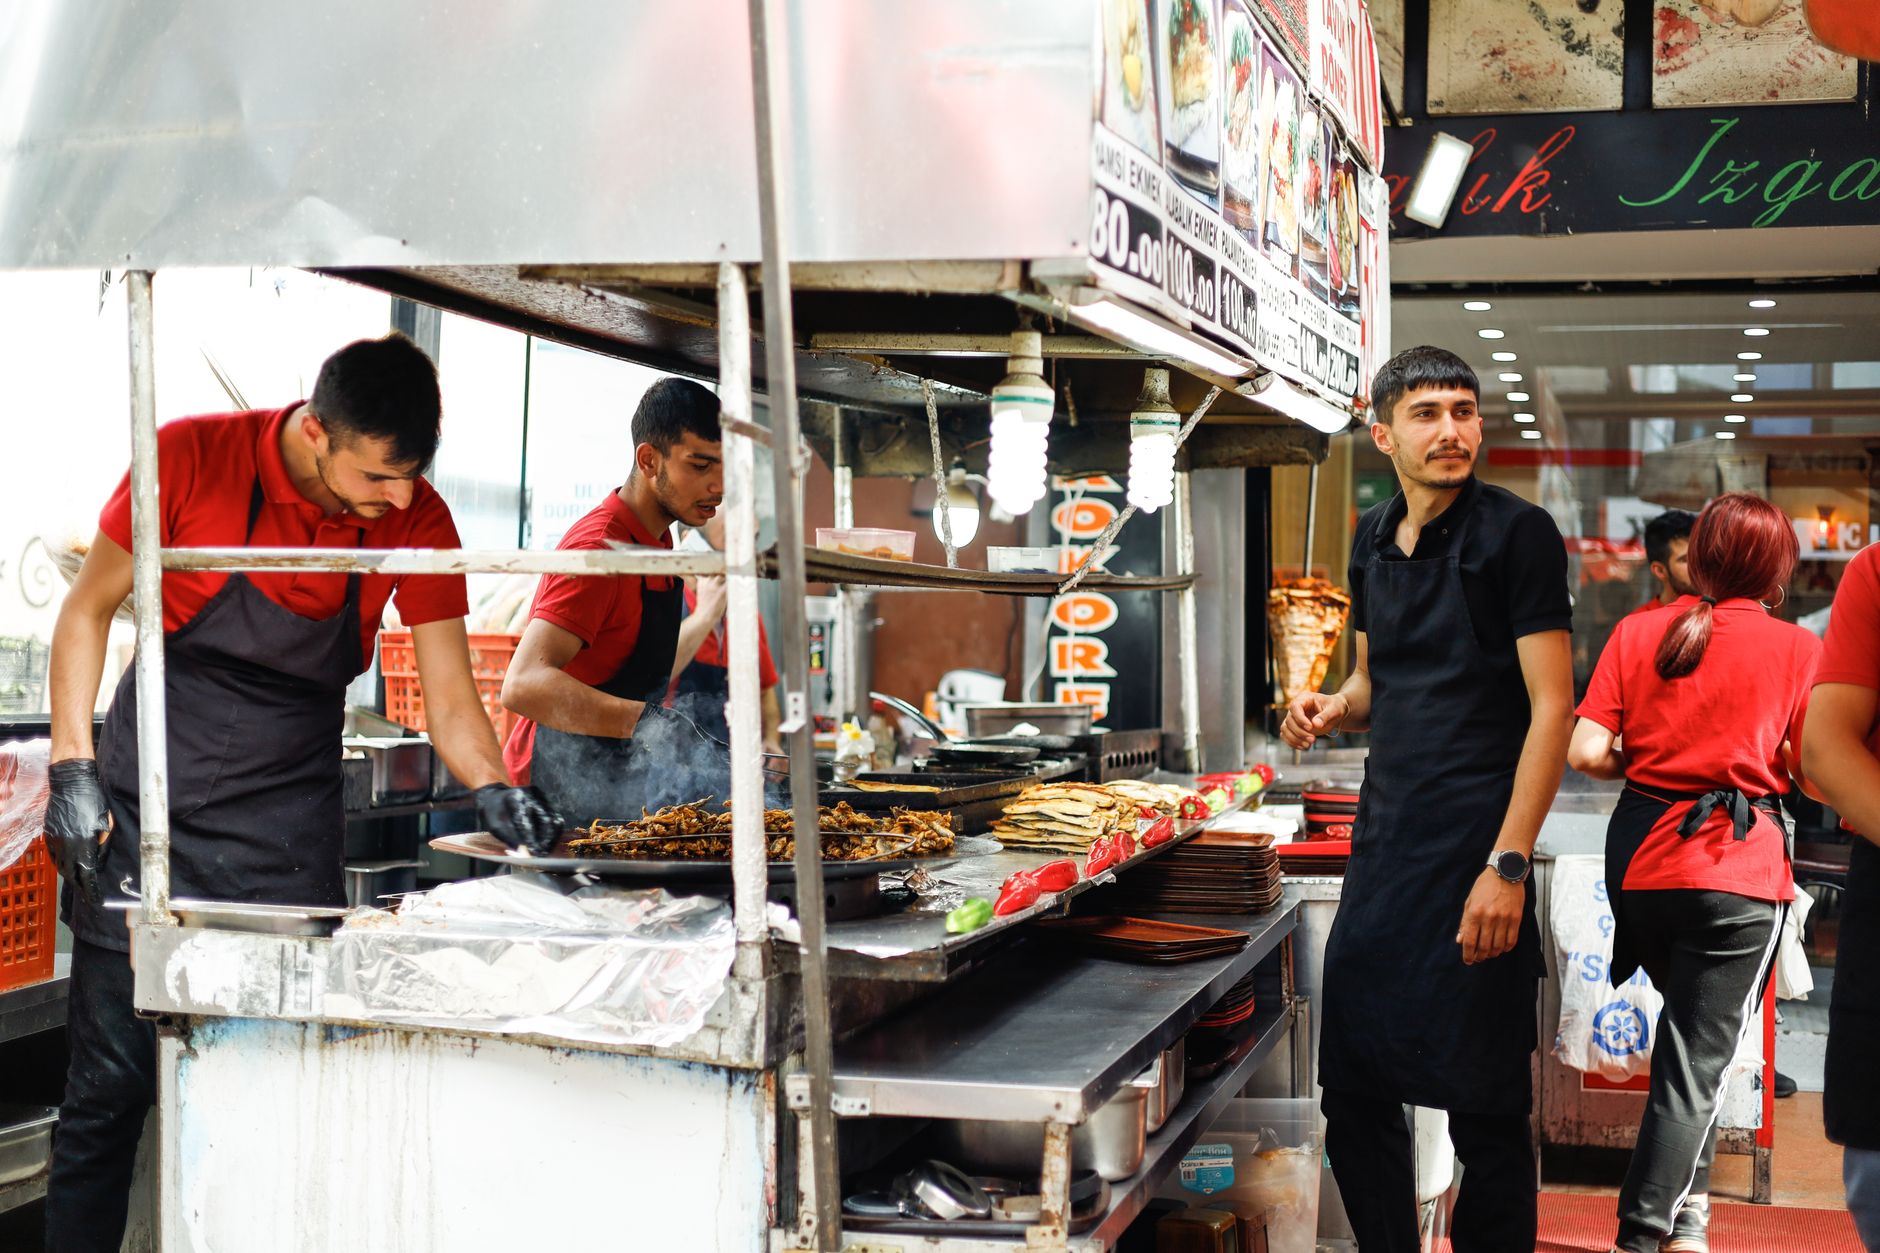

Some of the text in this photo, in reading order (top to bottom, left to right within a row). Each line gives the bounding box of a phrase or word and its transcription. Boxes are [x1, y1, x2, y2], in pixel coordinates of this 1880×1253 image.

[1130, 160, 1163, 208] EKMEK
[1089, 187, 1163, 284] 80.00
[1194, 211, 1219, 251] EKMEK
[1167, 236, 1214, 317] 100.00
[1223, 273, 1257, 344] 100.00
